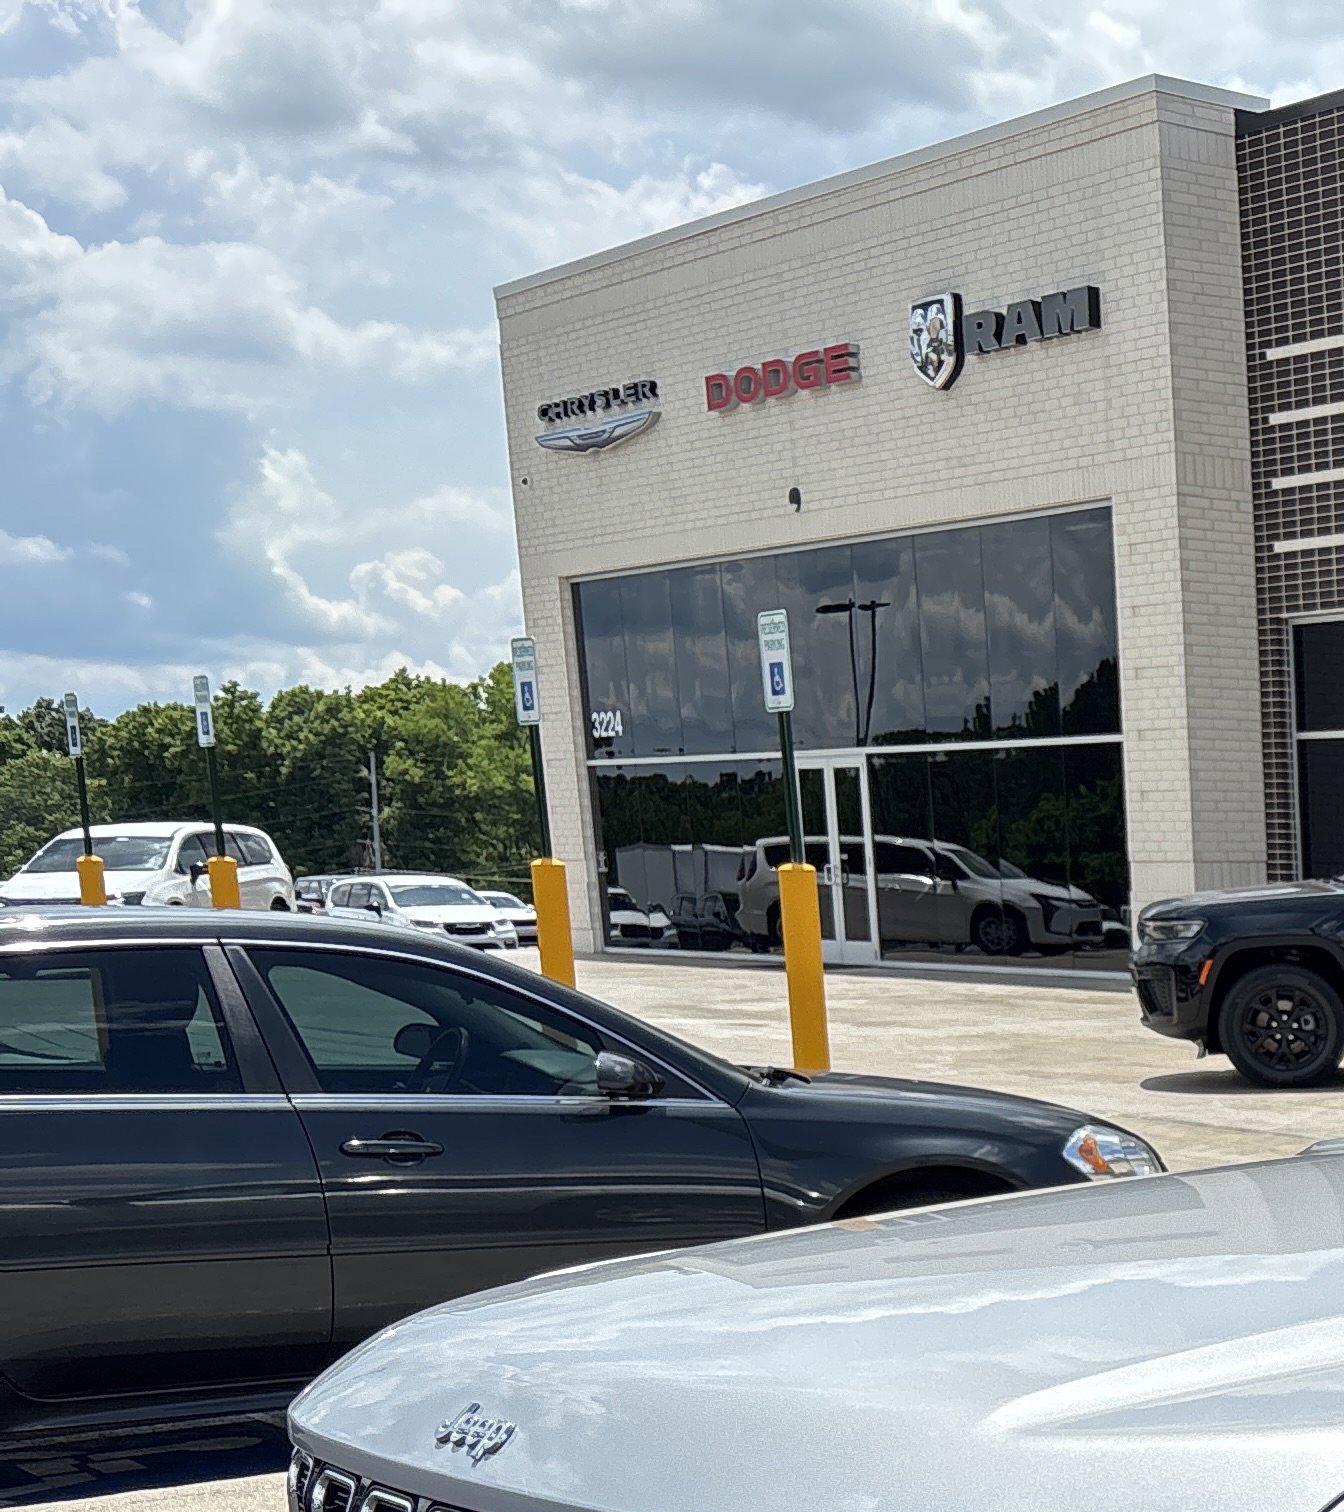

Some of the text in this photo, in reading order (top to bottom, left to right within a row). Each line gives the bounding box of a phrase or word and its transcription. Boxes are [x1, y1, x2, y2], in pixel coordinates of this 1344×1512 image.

[963, 285, 1100, 355] RAM
[537, 380, 659, 422] CHRYSLER
[704, 342, 860, 413] DODGE
[591, 710, 623, 739] 3224
[434, 1402, 518, 1462] Jeep
